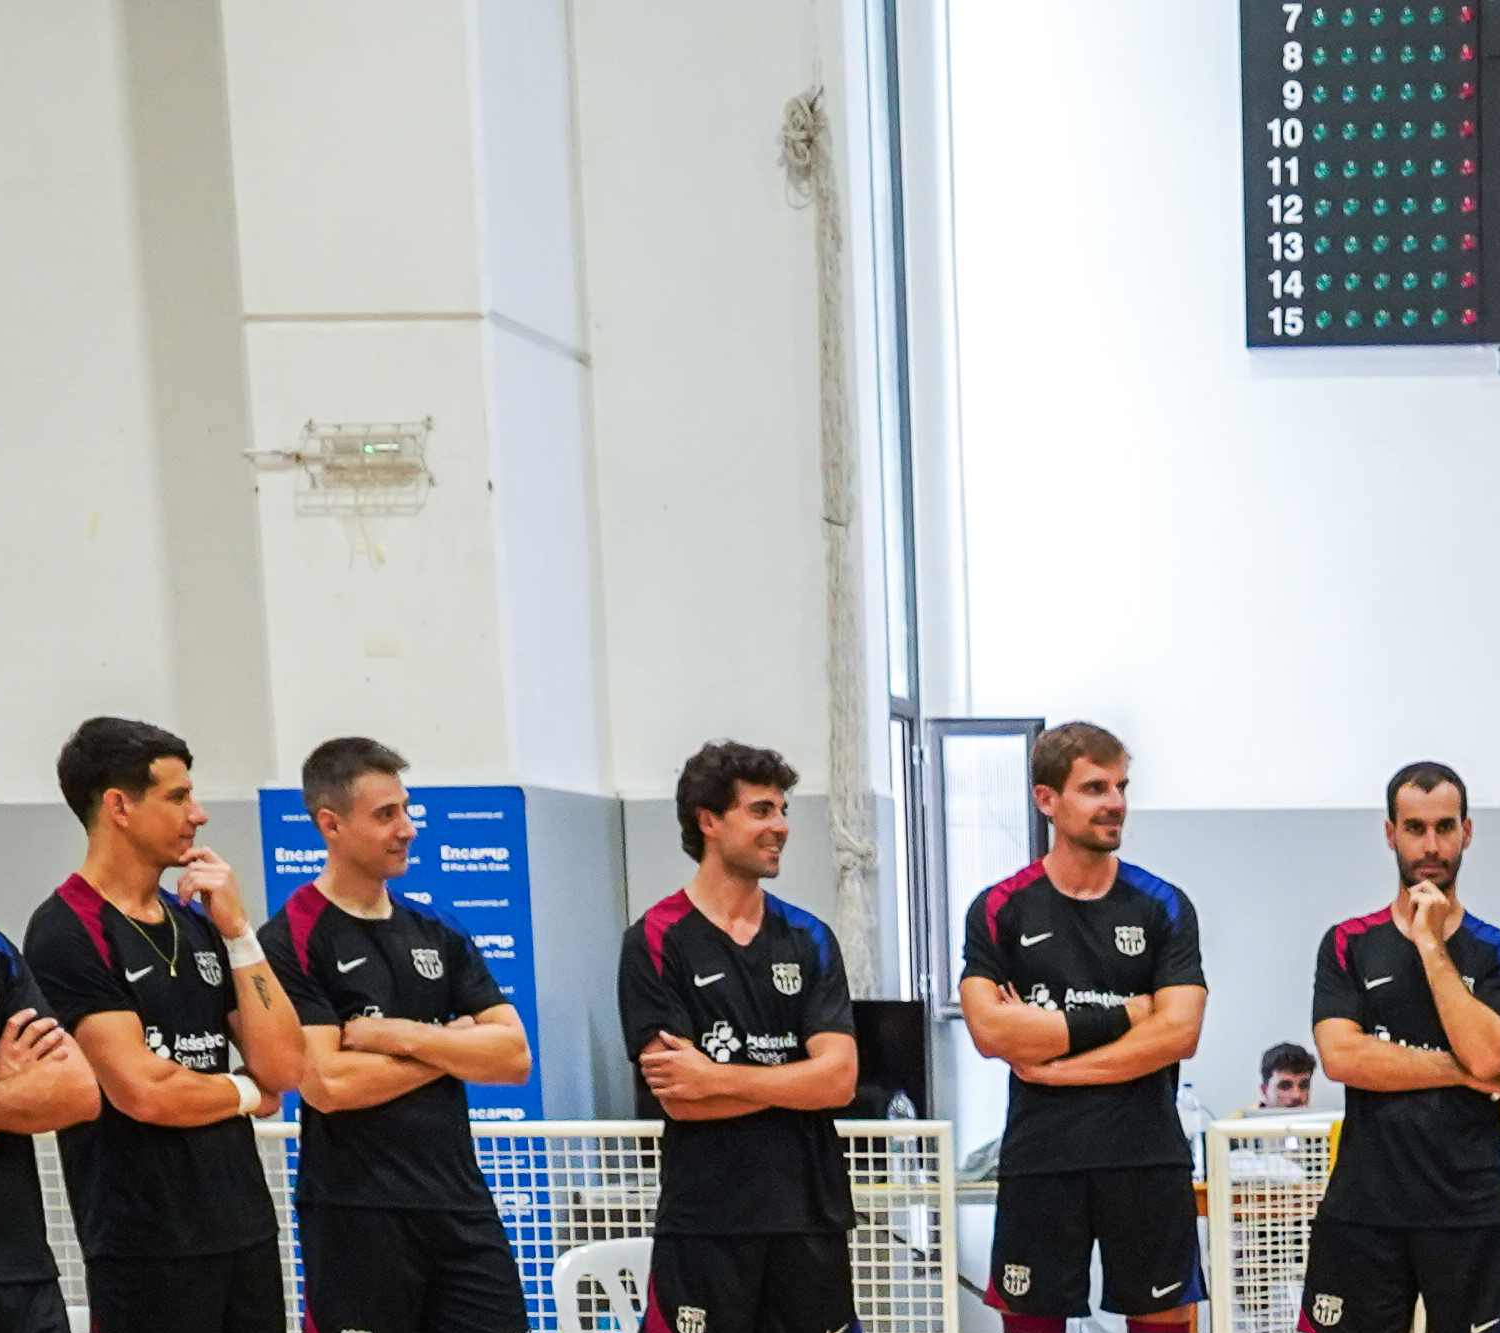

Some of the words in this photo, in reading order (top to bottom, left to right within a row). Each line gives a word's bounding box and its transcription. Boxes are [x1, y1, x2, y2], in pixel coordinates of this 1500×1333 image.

[1281, 3, 1303, 34] 7
[1282, 40, 1304, 73] 8
[1282, 79, 1304, 111] 9
[1266, 117, 1304, 148] 10
[1266, 156, 1299, 187] 11
[1266, 193, 1304, 225] 12
[1267, 231, 1304, 262] 13
[1267, 269, 1305, 300] 14
[1267, 306, 1304, 337] 15
[440, 844, 510, 861] Encamp
